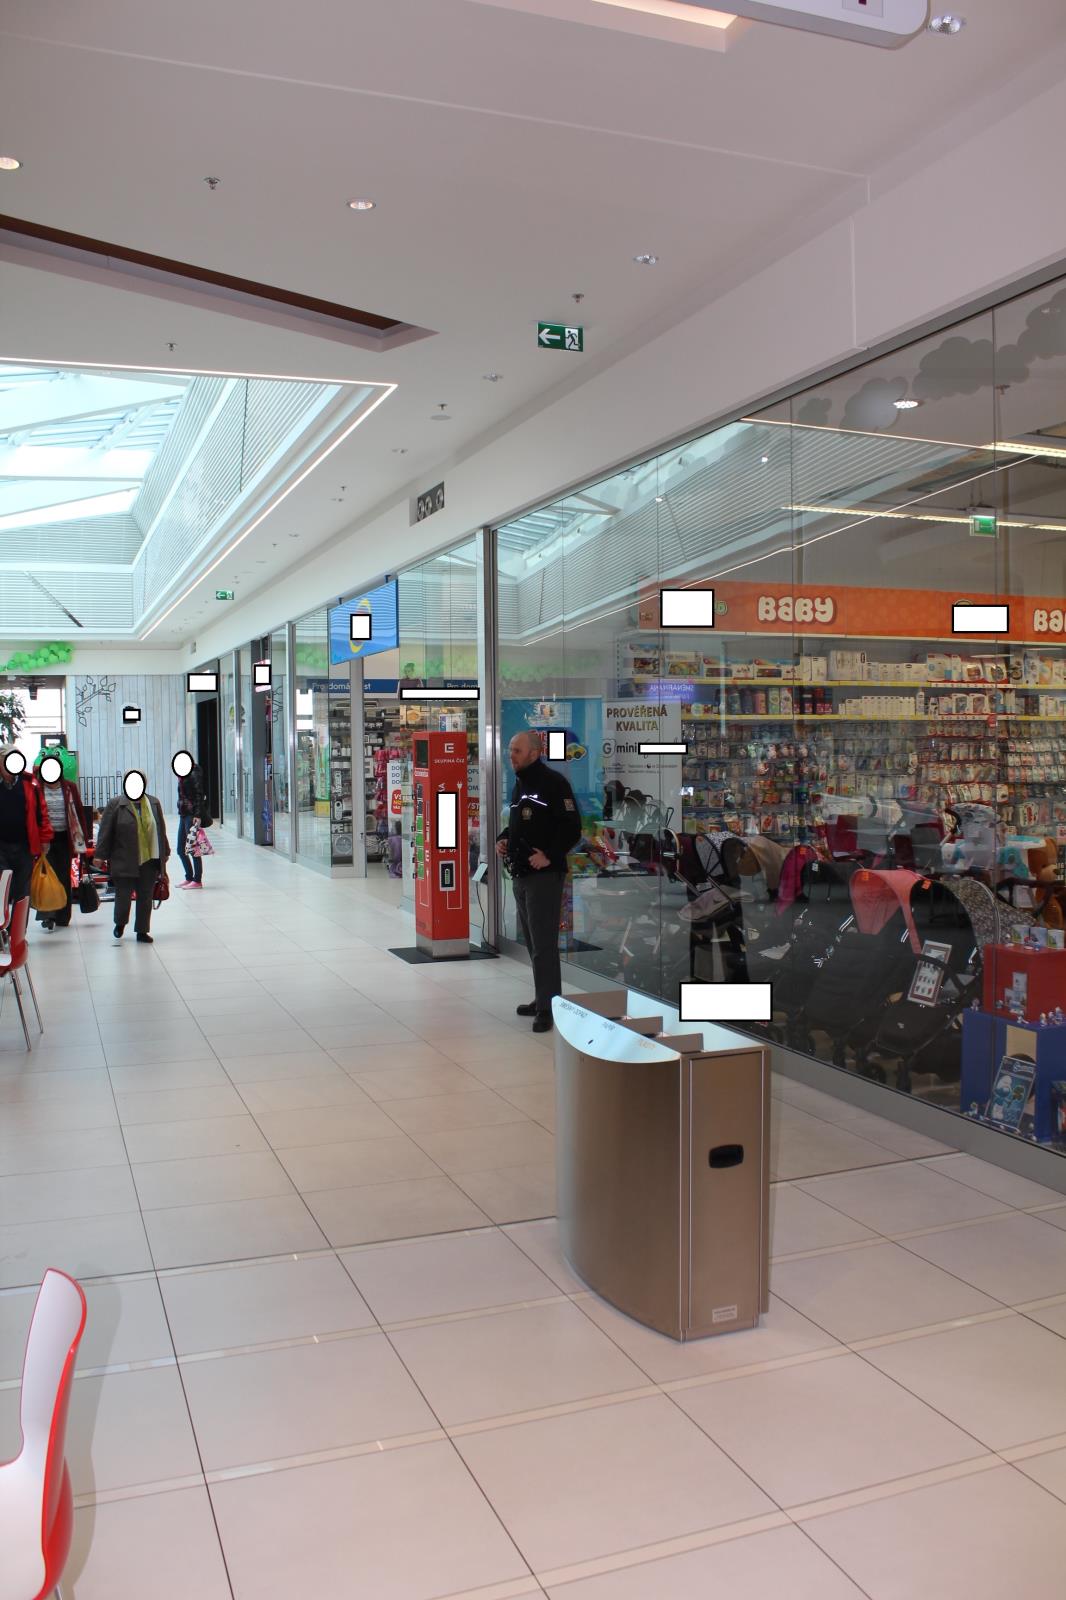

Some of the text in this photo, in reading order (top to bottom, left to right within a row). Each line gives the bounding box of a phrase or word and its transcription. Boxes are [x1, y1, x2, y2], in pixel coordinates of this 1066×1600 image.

[1033, 609, 1066, 632] BA
[606, 704, 668, 718] PROVĚŘENÁ
[616, 720, 658, 731] KVALITA
